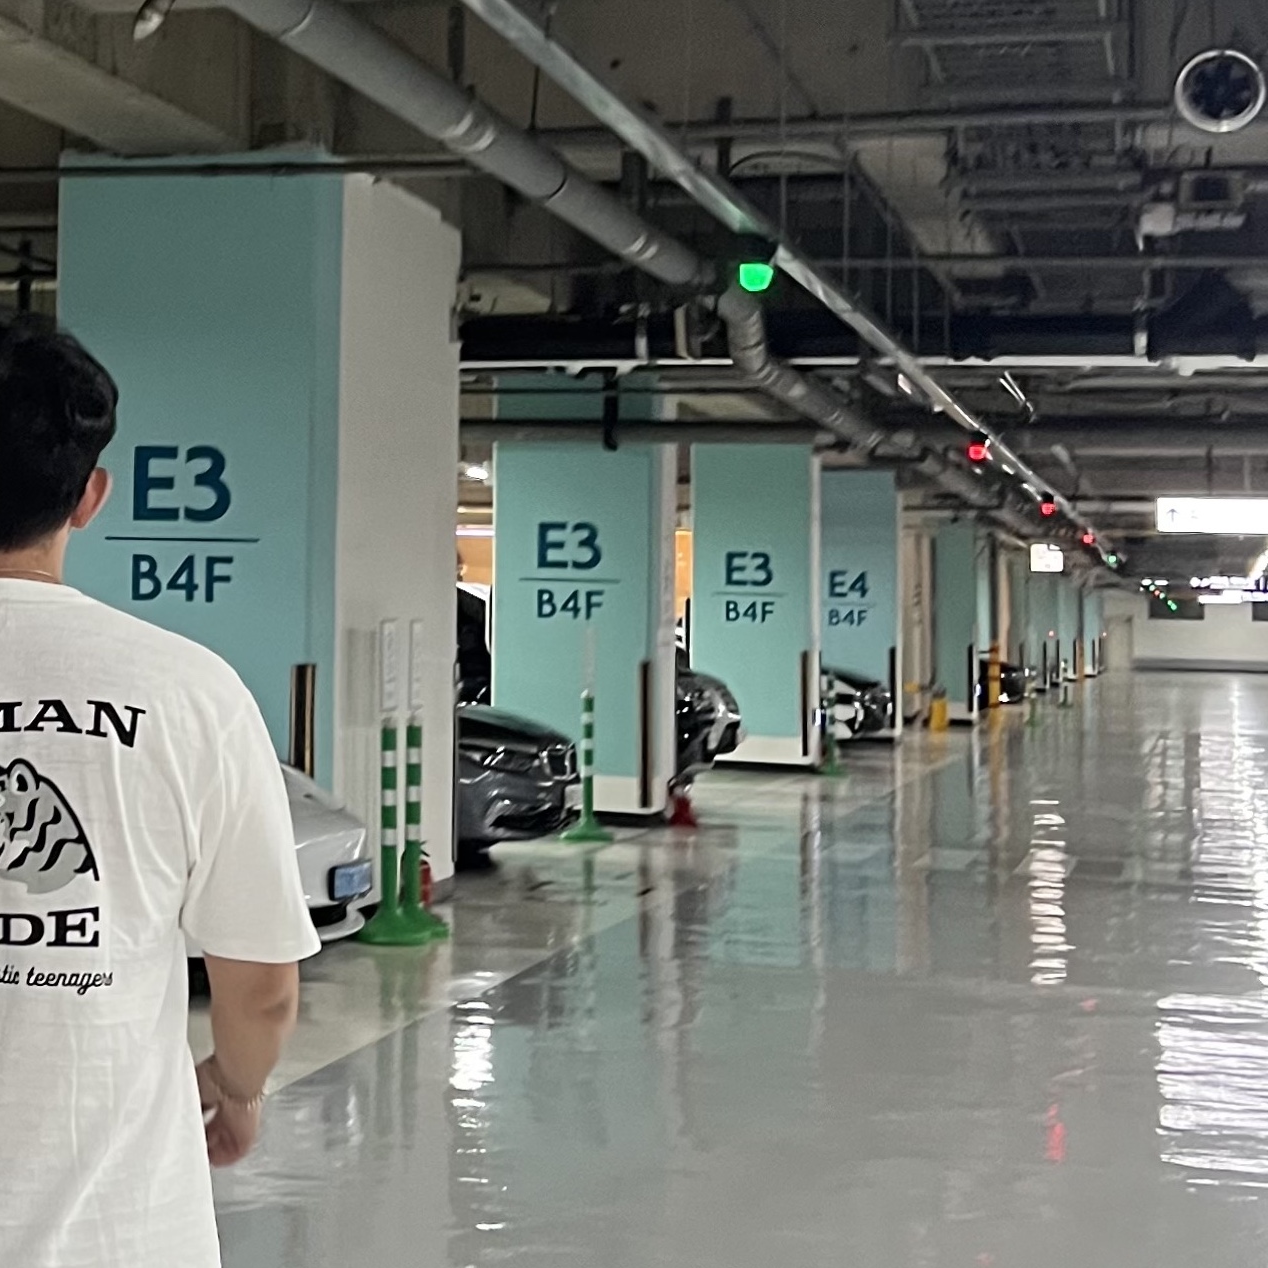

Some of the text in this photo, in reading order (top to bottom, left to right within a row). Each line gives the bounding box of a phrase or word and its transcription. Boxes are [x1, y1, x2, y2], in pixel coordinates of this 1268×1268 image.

[132, 444, 232, 523] E3
[537, 521, 603, 570] E3
[131, 553, 234, 603] B4F
[725, 551, 775, 587] E3
[828, 569, 869, 599] E4
[537, 588, 605, 621] B4F
[725, 600, 775, 624] B4F
[828, 608, 868, 627] B4F
